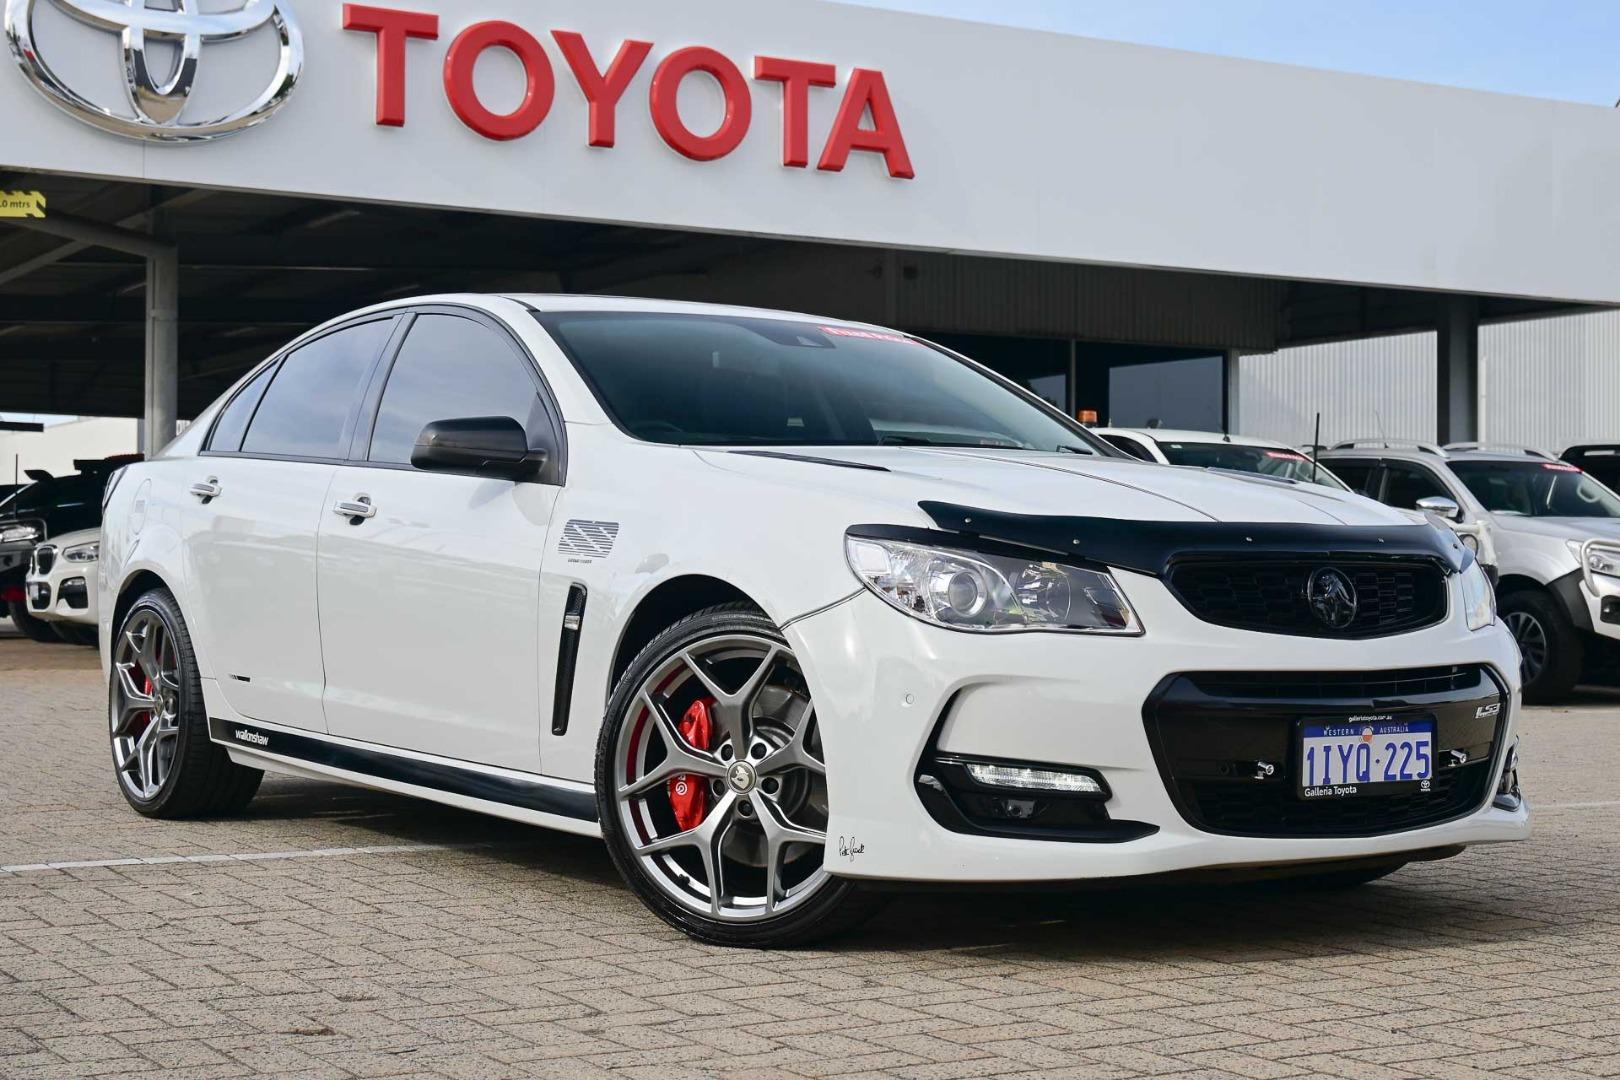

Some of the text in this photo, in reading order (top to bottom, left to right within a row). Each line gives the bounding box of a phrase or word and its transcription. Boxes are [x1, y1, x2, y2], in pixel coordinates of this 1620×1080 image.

[342, 3, 914, 179] TOYOTA
[10, 200, 31, 208] mtrs
[1323, 725, 1409, 736] WESTERN AUSTRALIA
[1304, 785, 1357, 797] Galleria Toyota
